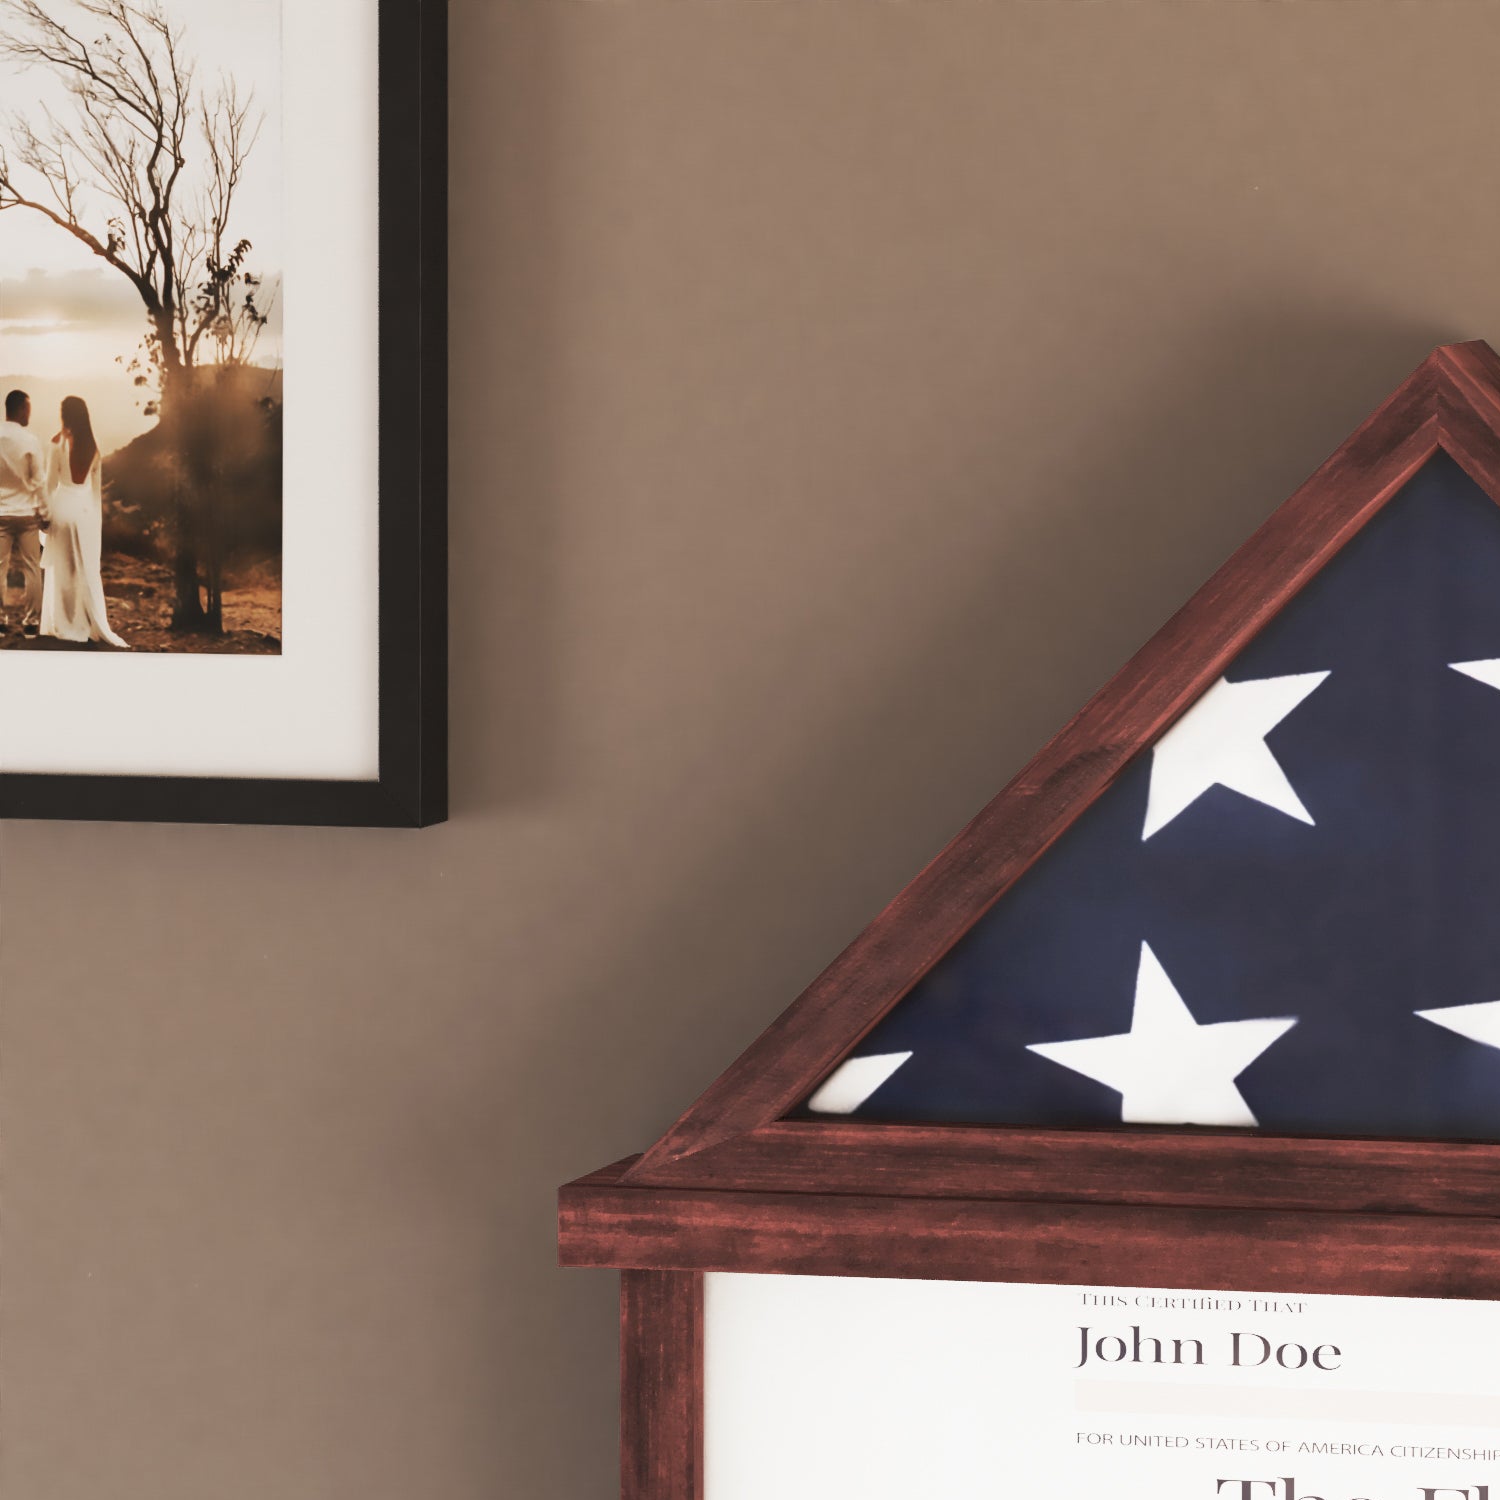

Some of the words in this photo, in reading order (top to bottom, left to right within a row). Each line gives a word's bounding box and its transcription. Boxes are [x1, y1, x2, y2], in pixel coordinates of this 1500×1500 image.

[1077, 1290, 1129, 1310] THIS
[1247, 1299, 1309, 1314] THAT
[1072, 1325, 1206, 1369] John
[1229, 1332, 1344, 1371] Doe
[1076, 1431, 1114, 1447] FOR
[1119, 1433, 1190, 1449] UNITED
[1194, 1436, 1260, 1452] STATES
[1265, 1439, 1291, 1455] OF
[1296, 1440, 1385, 1457] AMERICA
